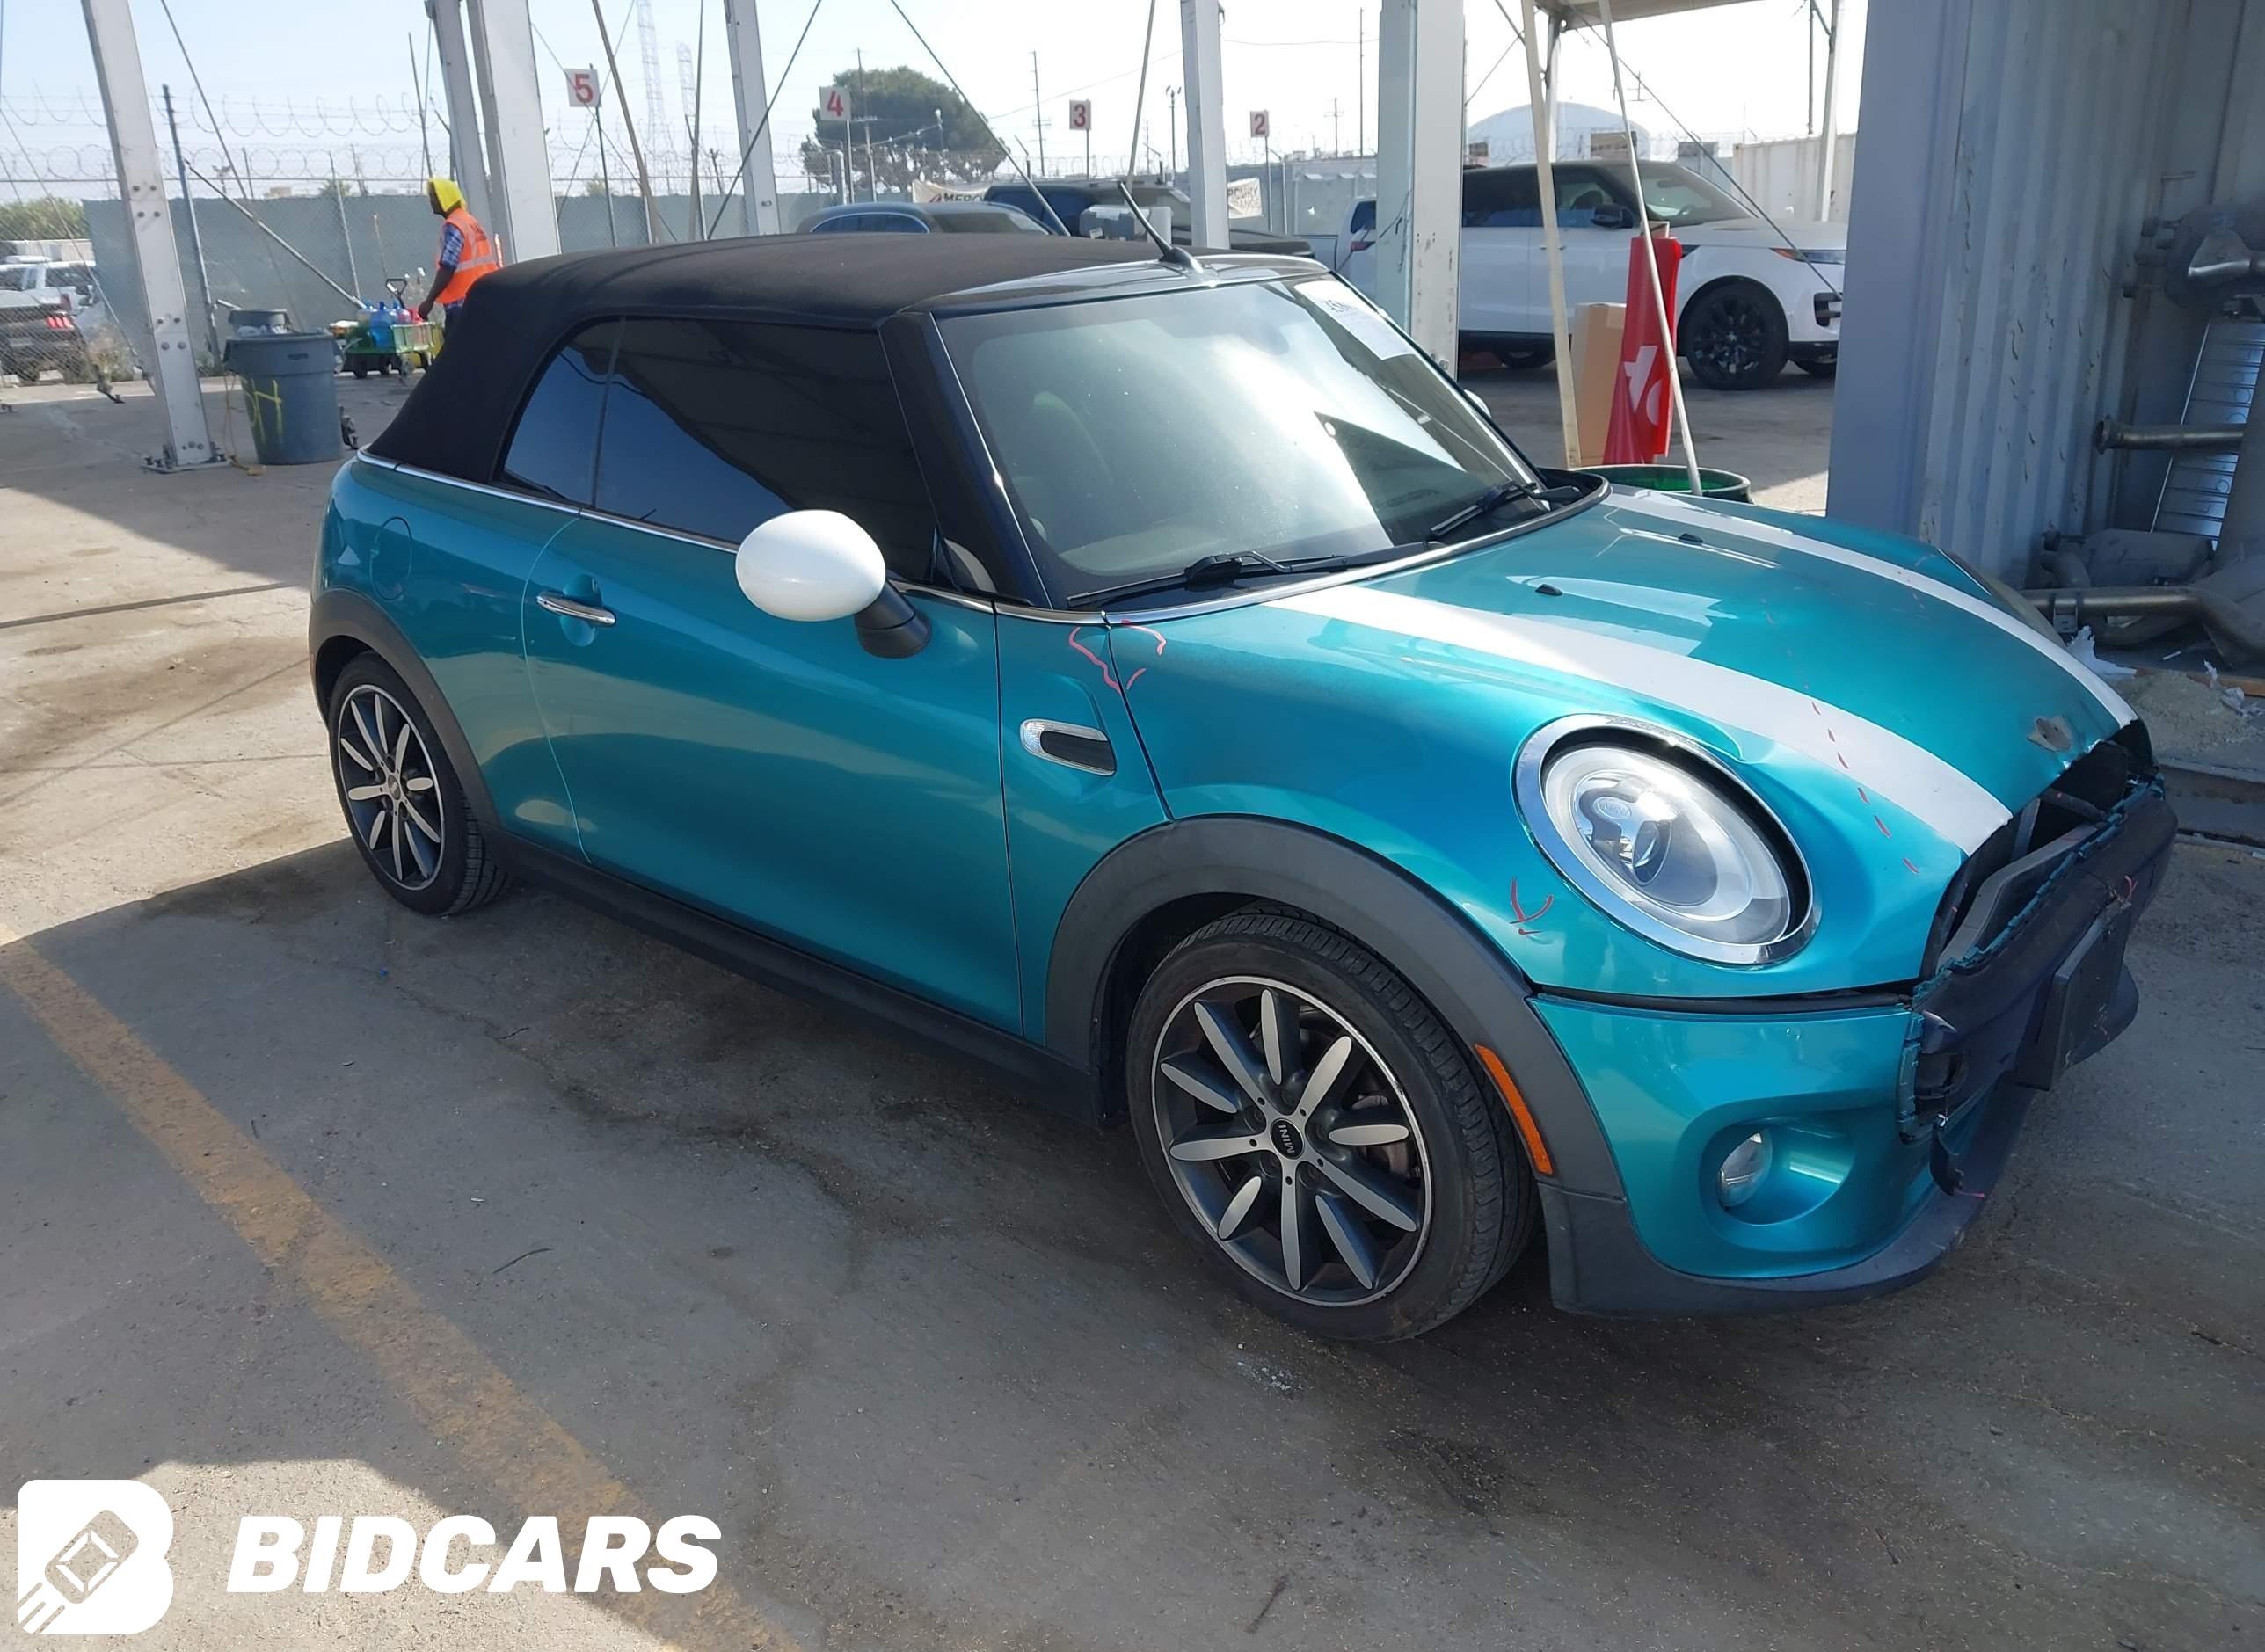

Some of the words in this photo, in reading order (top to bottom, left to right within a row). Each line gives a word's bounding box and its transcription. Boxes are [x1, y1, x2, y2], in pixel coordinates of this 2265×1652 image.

[575, 74, 593, 103] 5
[827, 91, 844, 116] 4
[1074, 103, 1086, 127] 3
[1255, 113, 1265, 135] 2
[1278, 1124, 1295, 1153] MINI
